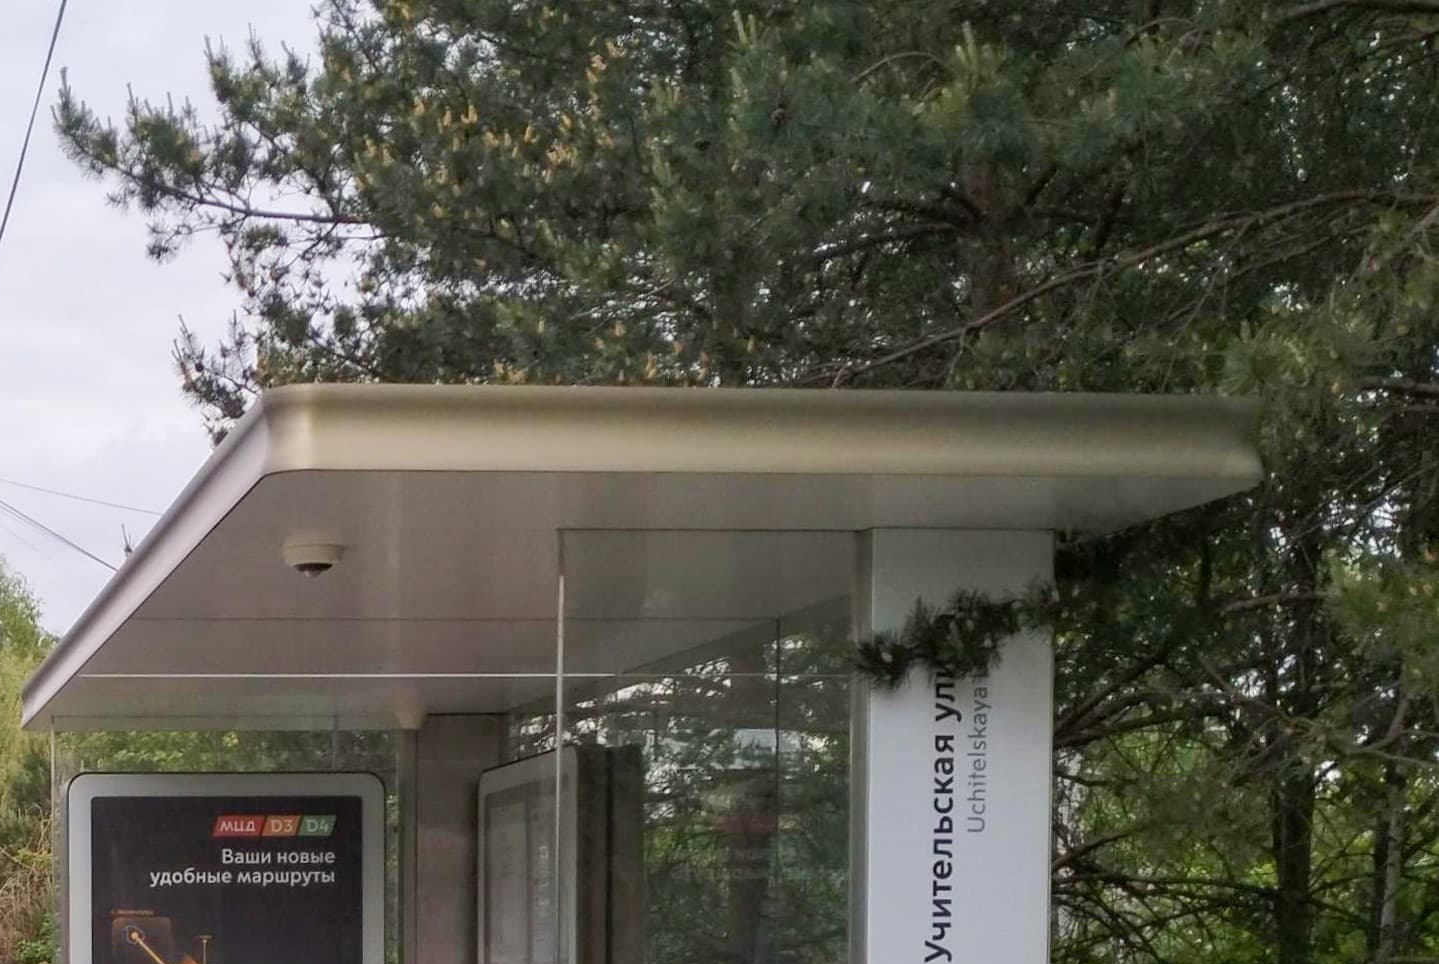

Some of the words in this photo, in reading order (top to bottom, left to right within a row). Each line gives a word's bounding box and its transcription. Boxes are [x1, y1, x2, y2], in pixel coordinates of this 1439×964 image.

[967, 686, 992, 833] Uchitelskaya
[219, 819, 256, 833] МЦД
[271, 818, 294, 833] D3
[305, 818, 329, 833] D4
[221, 848, 272, 865] Ваши
[277, 851, 336, 865] новые
[924, 734, 955, 963] Учительская
[149, 867, 233, 888] удобные
[237, 870, 336, 887] маршруты
